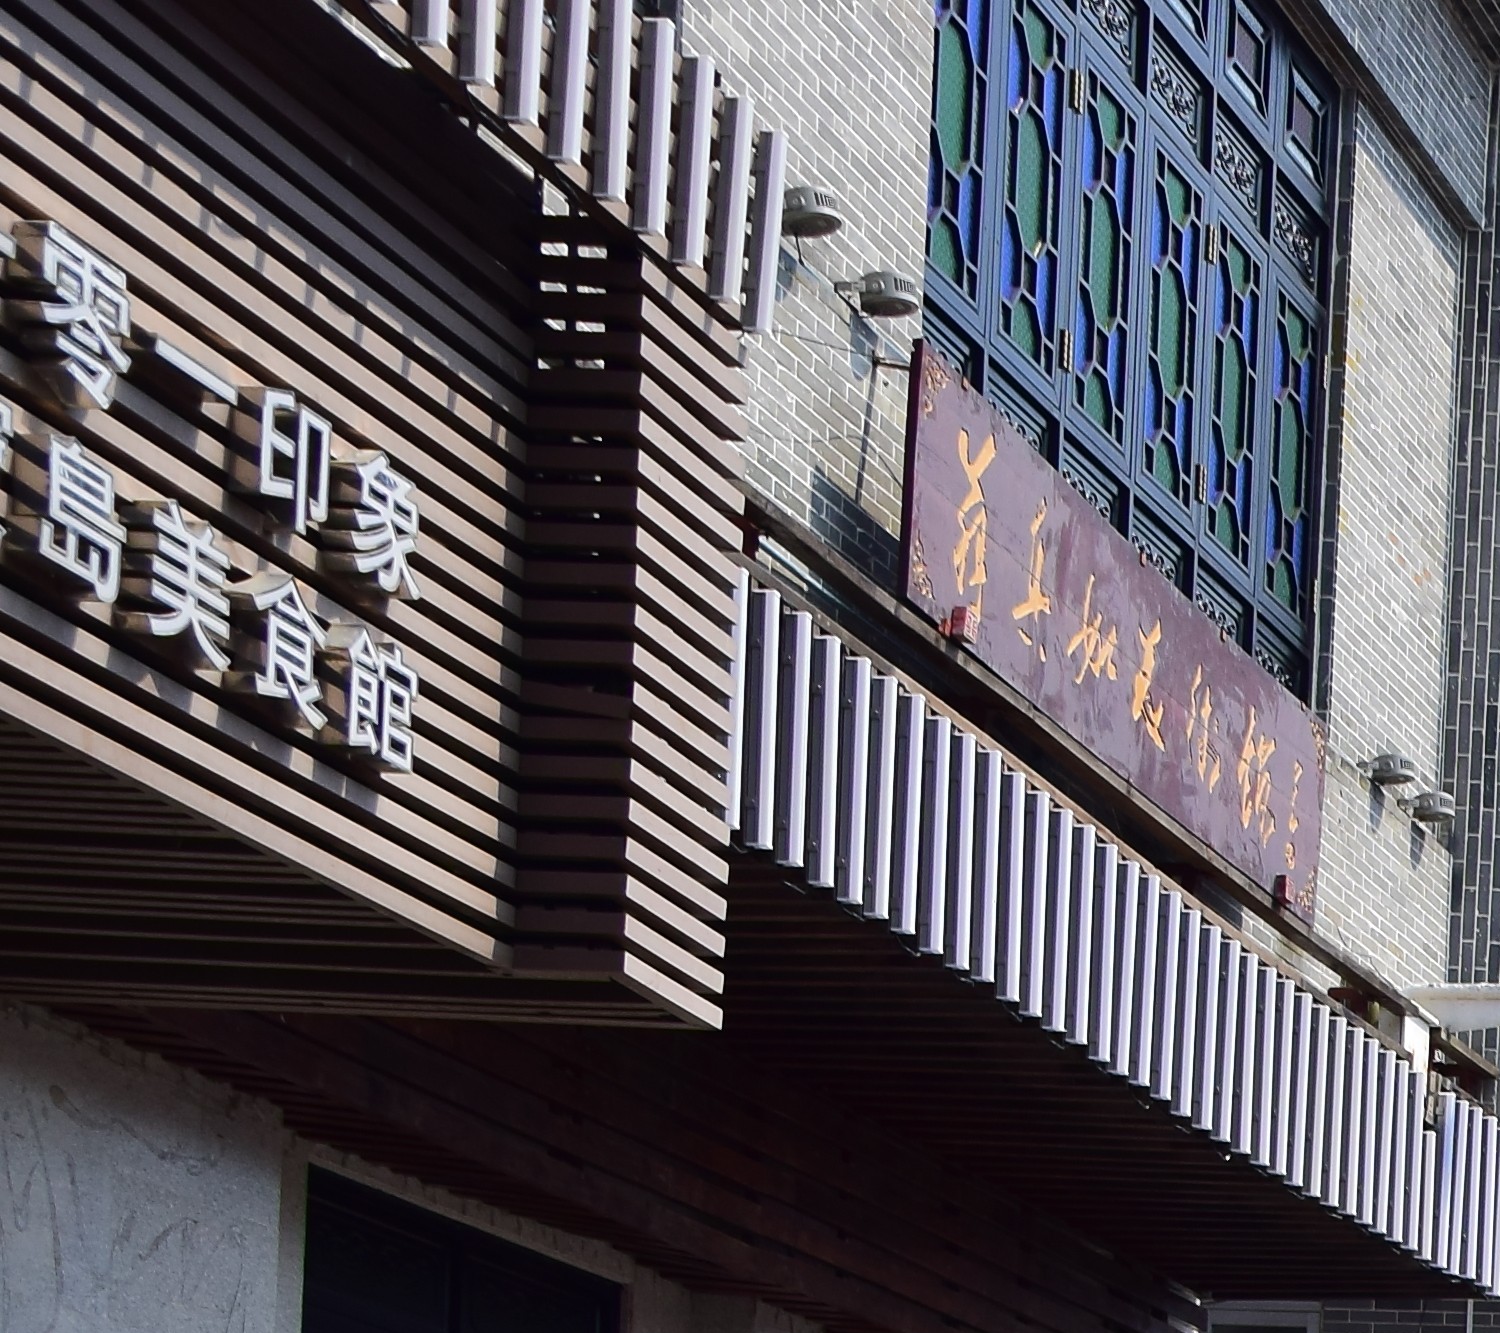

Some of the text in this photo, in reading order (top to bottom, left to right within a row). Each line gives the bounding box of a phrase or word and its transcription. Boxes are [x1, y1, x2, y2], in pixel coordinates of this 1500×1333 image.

[0, 219, 421, 600] 零一印象
[0, 406, 419, 775] 島美食館
